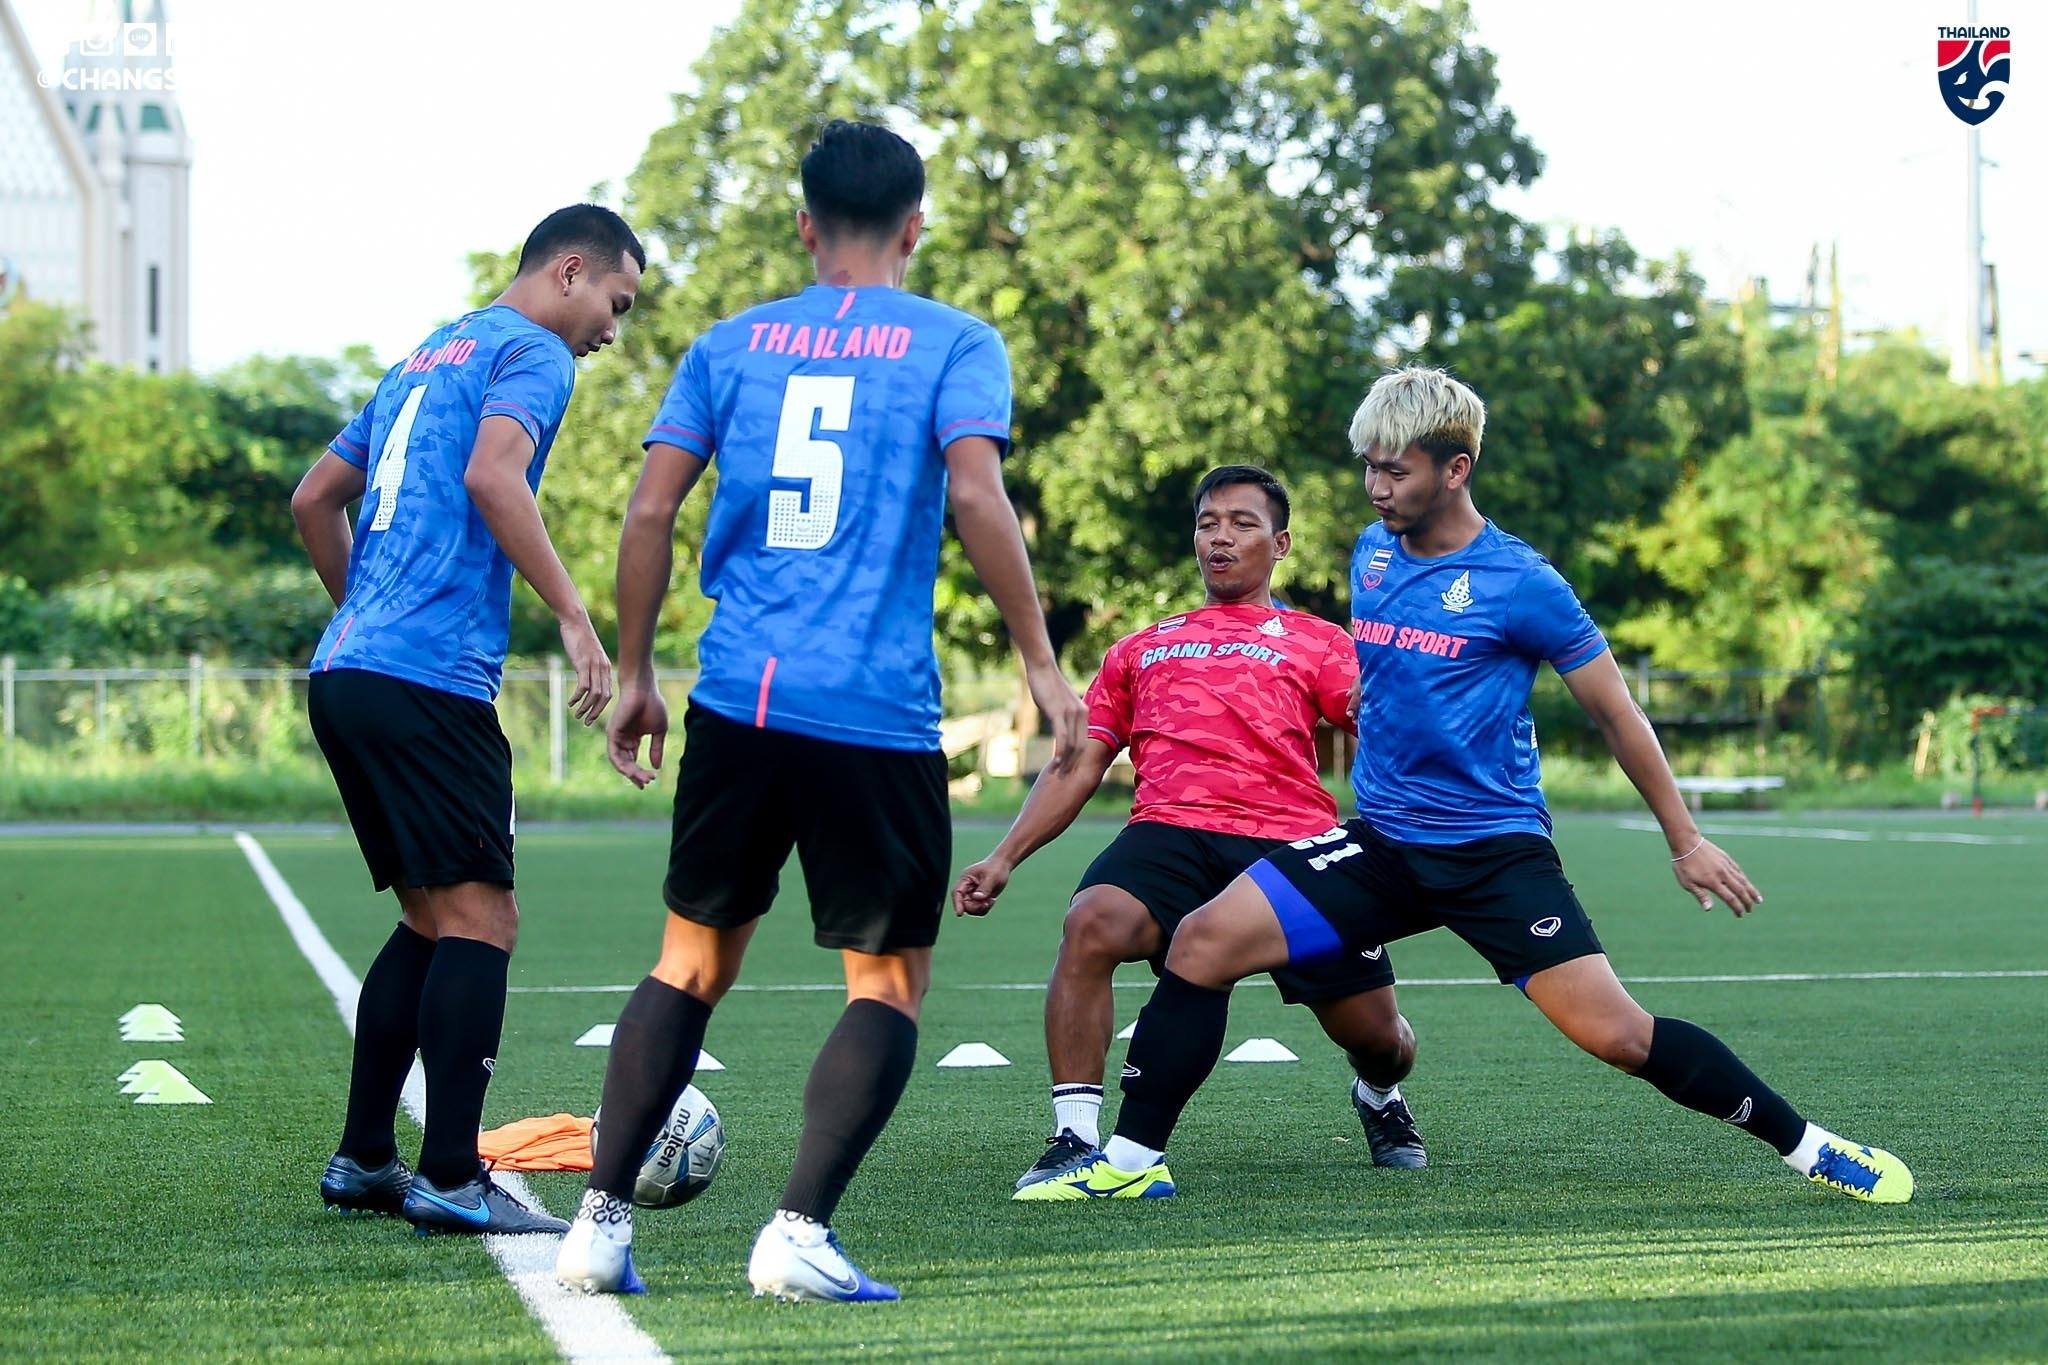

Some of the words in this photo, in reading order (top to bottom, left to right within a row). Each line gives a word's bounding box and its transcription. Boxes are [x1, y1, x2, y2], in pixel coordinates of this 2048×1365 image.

[748, 322, 912, 359] THAILAND
[371, 384, 428, 531] 4
[766, 374, 856, 550] 5
[1141, 642, 1212, 669] GRAND
[1213, 642, 1288, 666] SPORT
[1352, 617, 1395, 646] RAND
[1395, 626, 1468, 658] SPORT
[657, 1108, 691, 1168] molten
